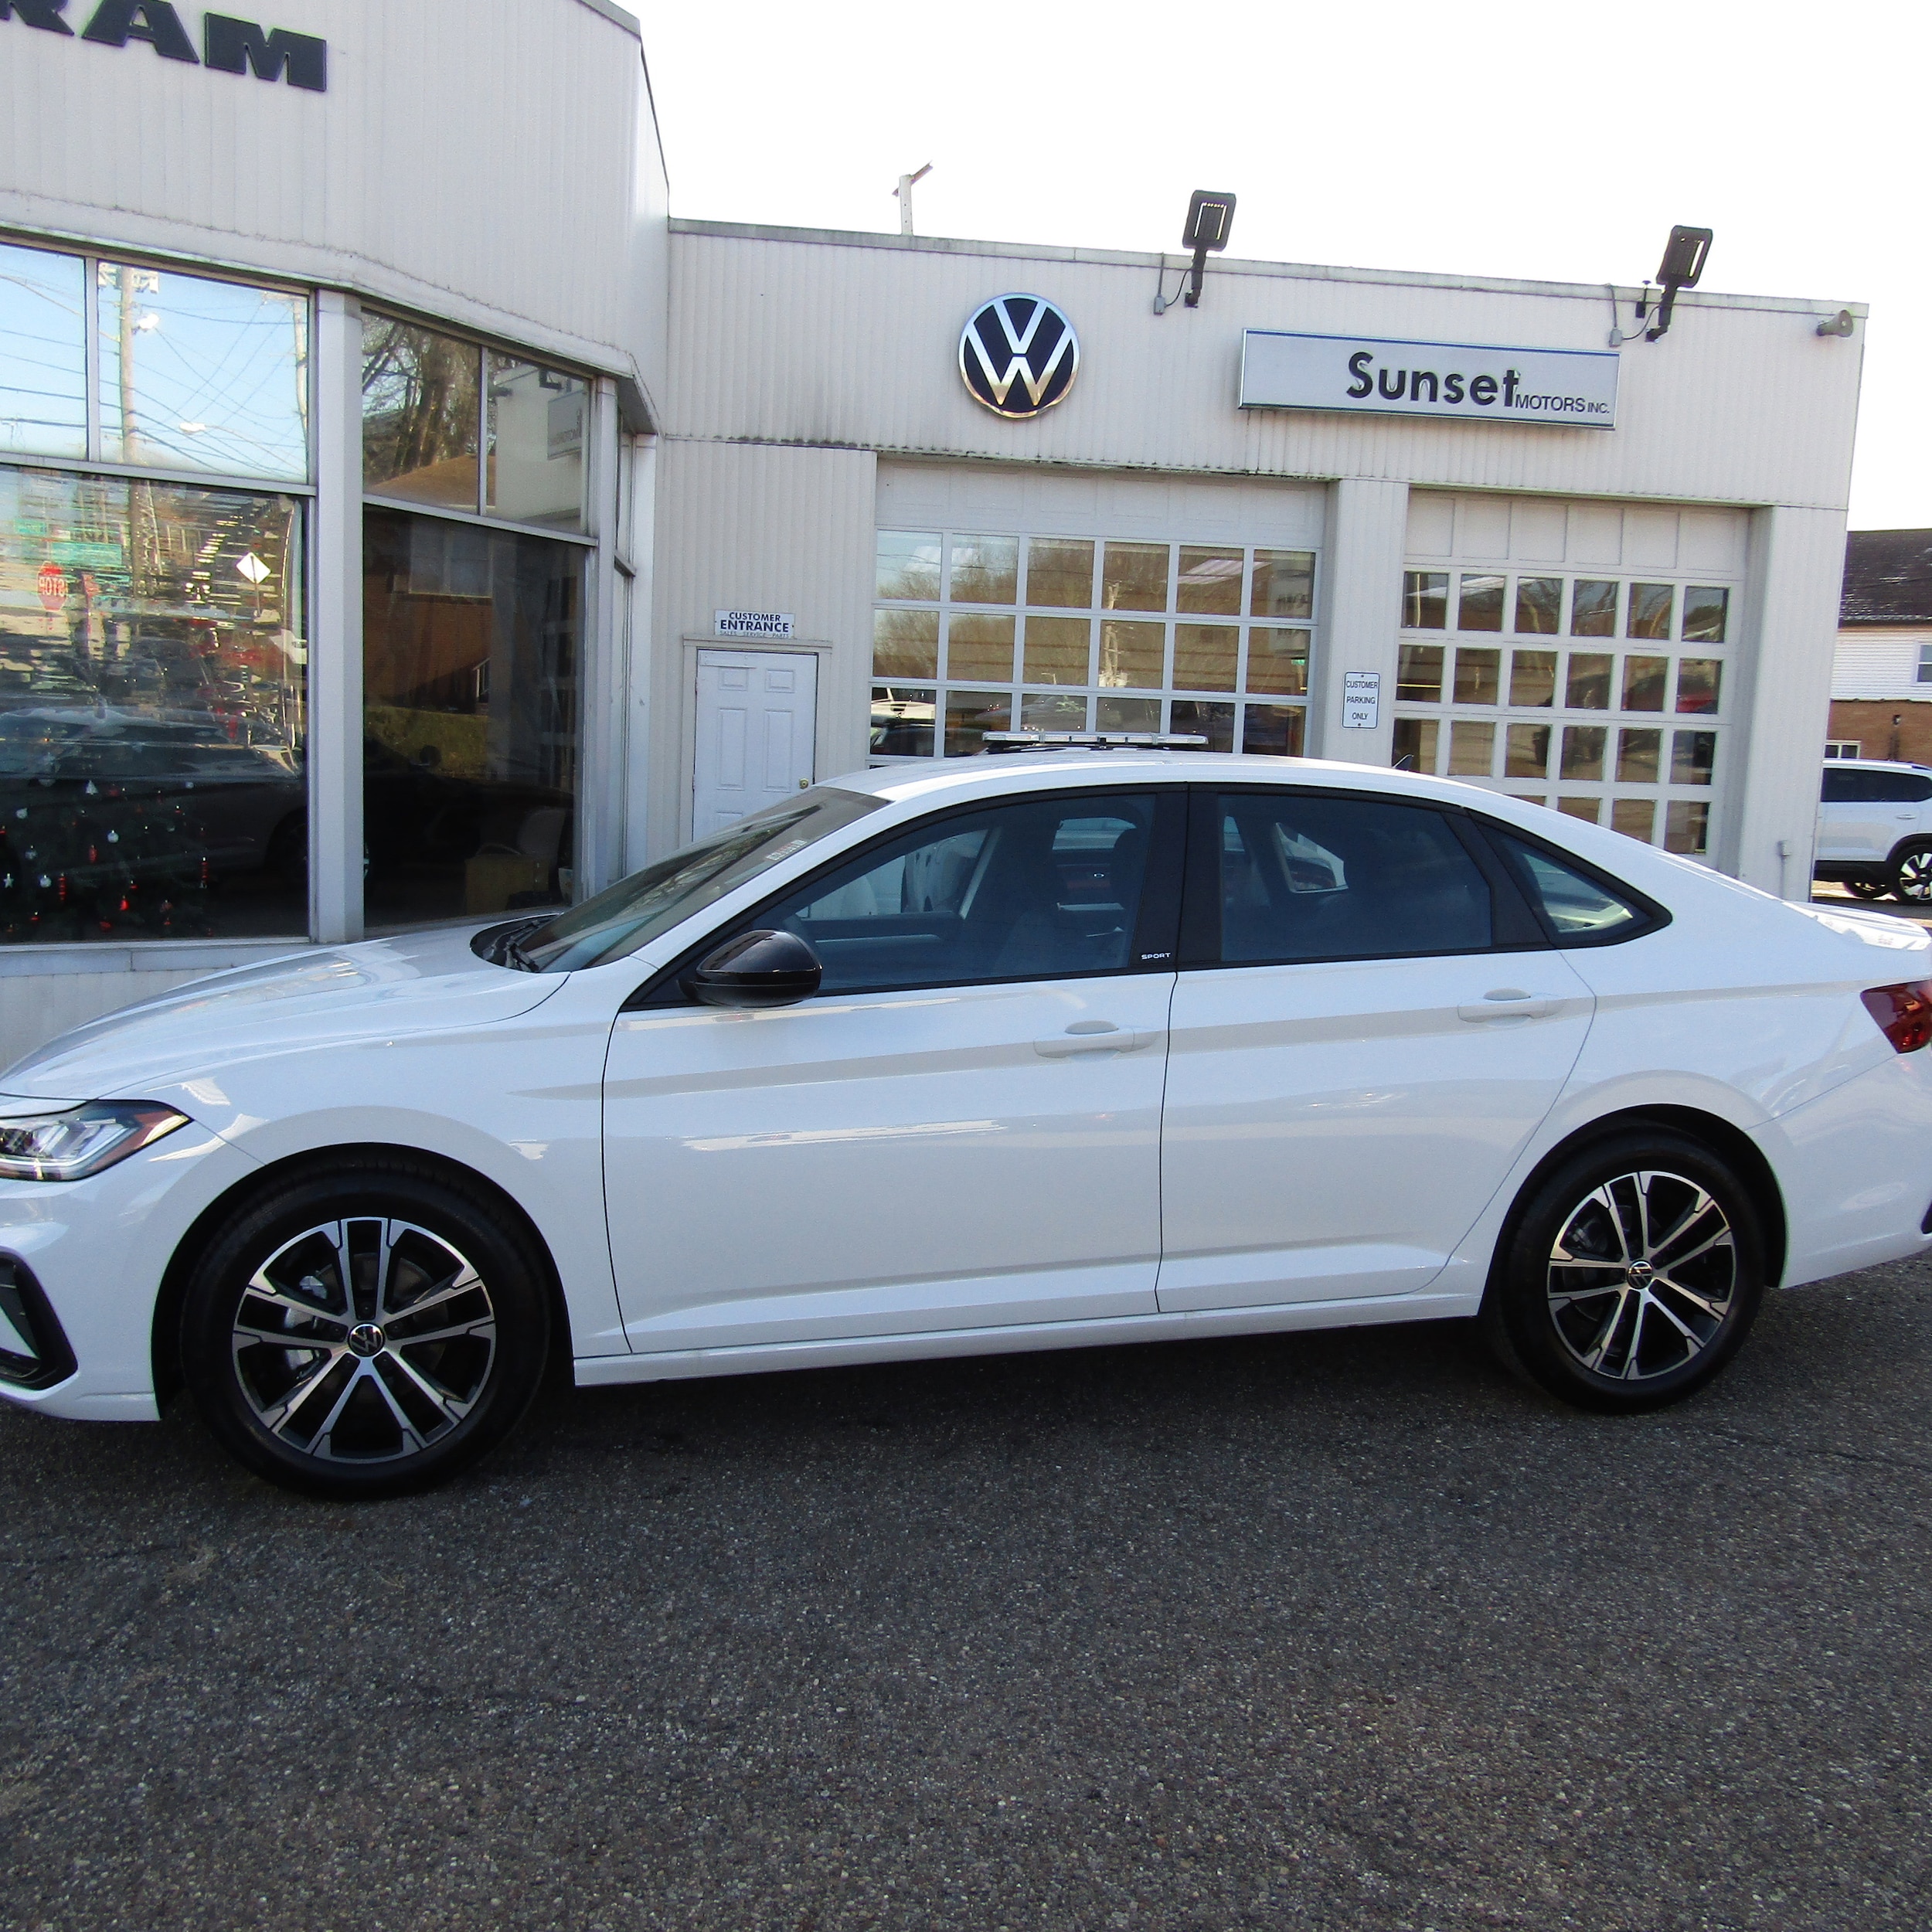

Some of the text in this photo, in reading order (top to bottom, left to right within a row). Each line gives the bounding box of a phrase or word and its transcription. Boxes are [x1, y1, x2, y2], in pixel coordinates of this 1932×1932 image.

[1346, 352, 1610, 413] Sunset MOTORS INC.
[729, 611, 781, 621] CUSTOMER
[720, 619, 788, 632] ENTRANCE
